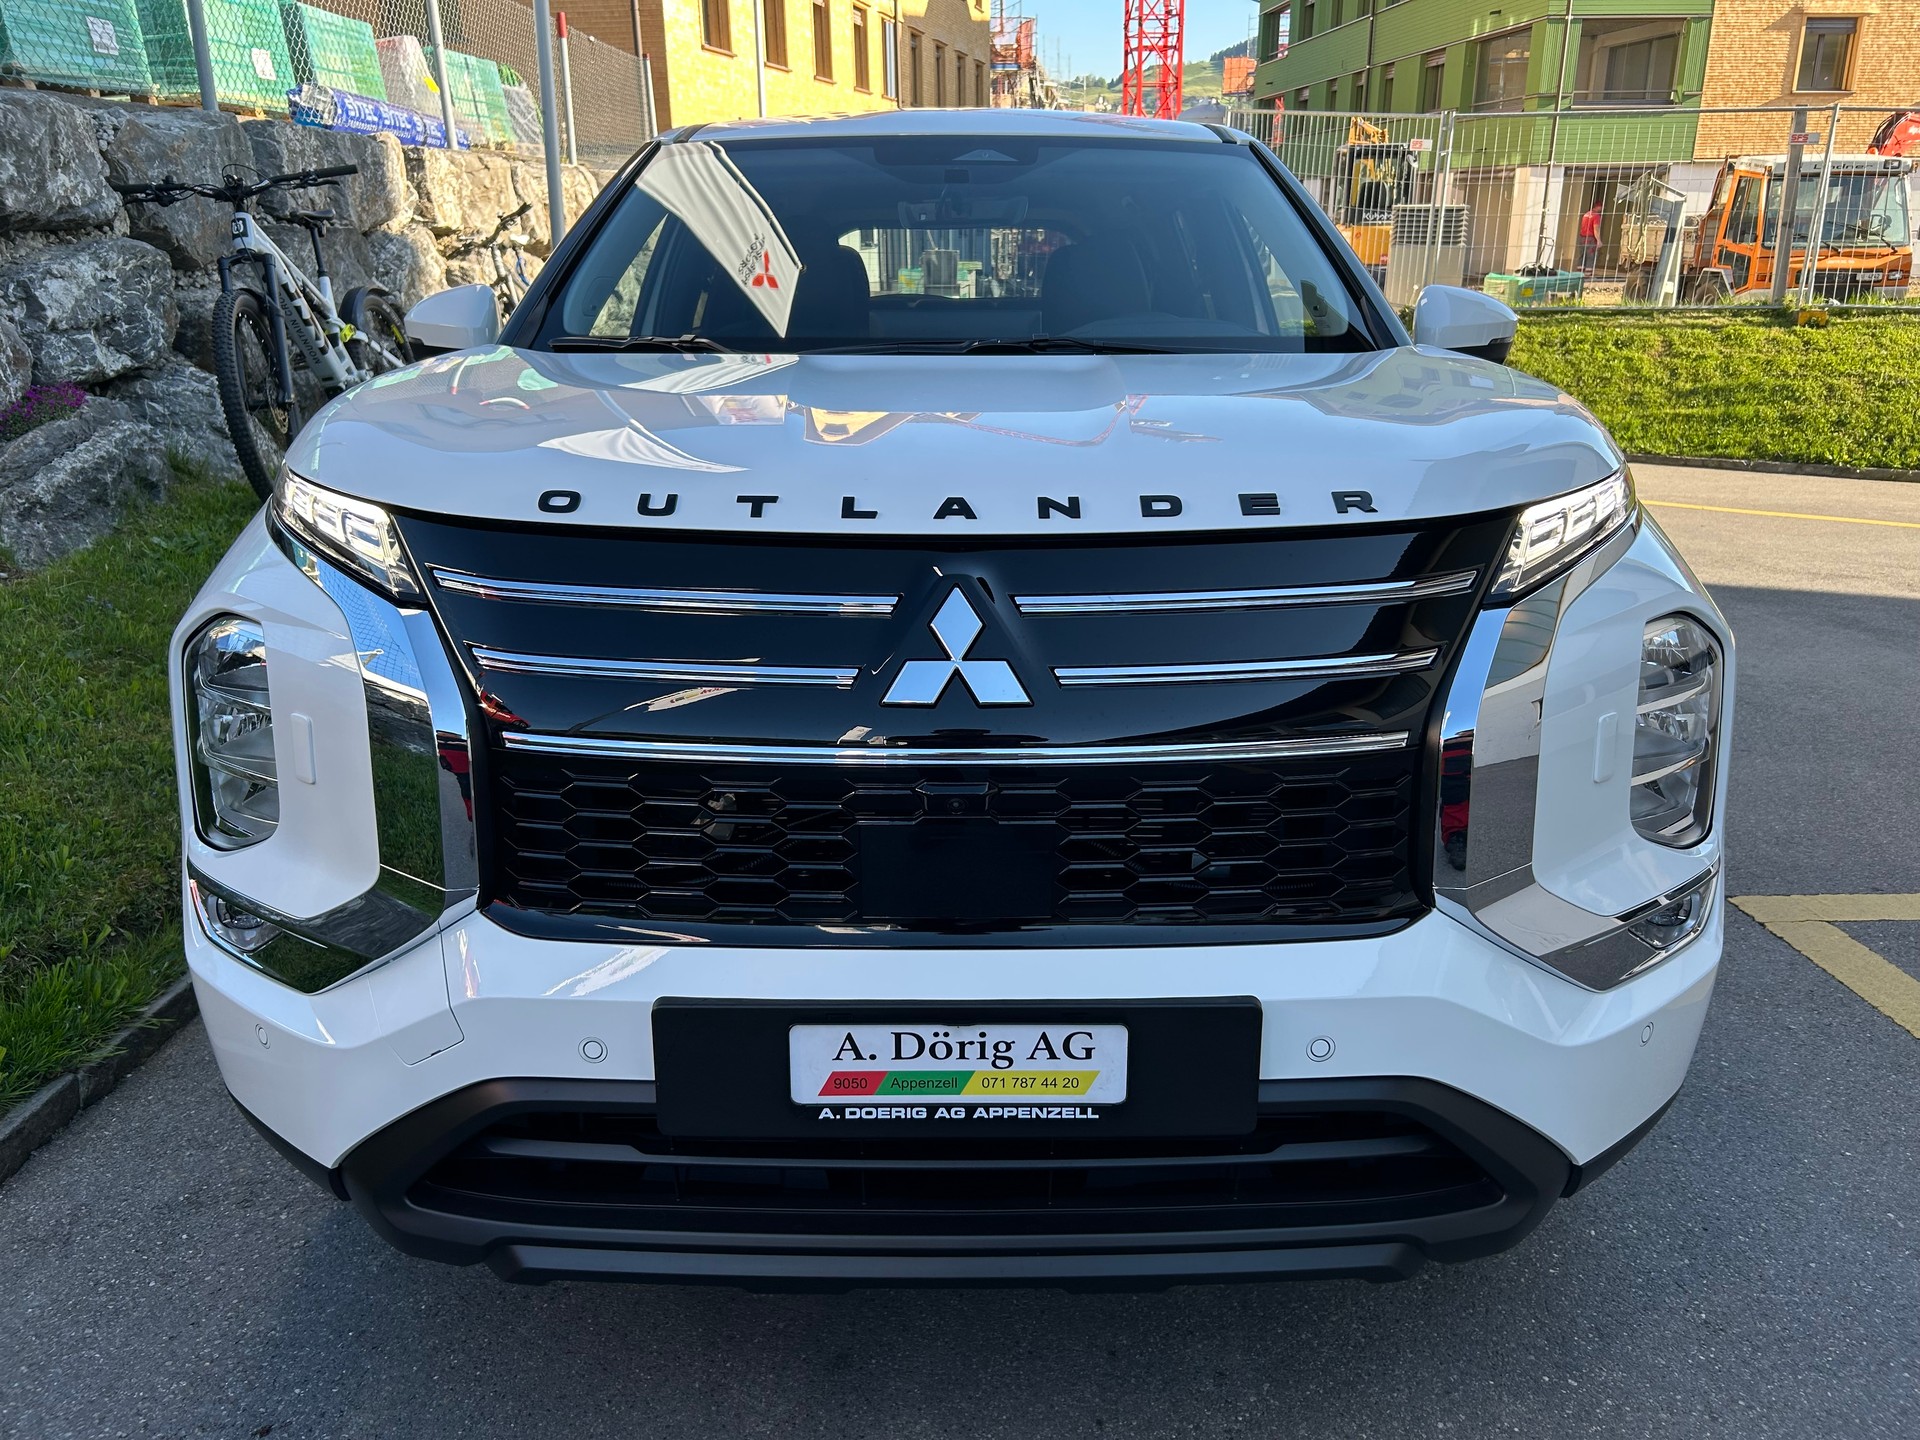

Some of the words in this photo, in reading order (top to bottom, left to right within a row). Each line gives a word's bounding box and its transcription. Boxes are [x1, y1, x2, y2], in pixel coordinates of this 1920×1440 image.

[291, 319, 322, 365] MOUNTAIN
[538, 490, 1380, 520] OUTLANDER
[832, 1032, 876, 1061] A.
[891, 1031, 1015, 1070] Dörig
[1026, 1031, 1096, 1061] AG
[833, 1077, 868, 1090] 9050
[890, 1077, 958, 1092] Appenzell
[981, 1077, 1005, 1089] 071
[1011, 1077, 1037, 1089] 787
[1040, 1077, 1058, 1089] 44
[1062, 1077, 1080, 1089] 20
[818, 1107, 841, 1120] A.
[845, 1107, 928, 1119] DOERIG
[934, 1107, 966, 1119] AG
[972, 1107, 1100, 1119] APPENZELL
